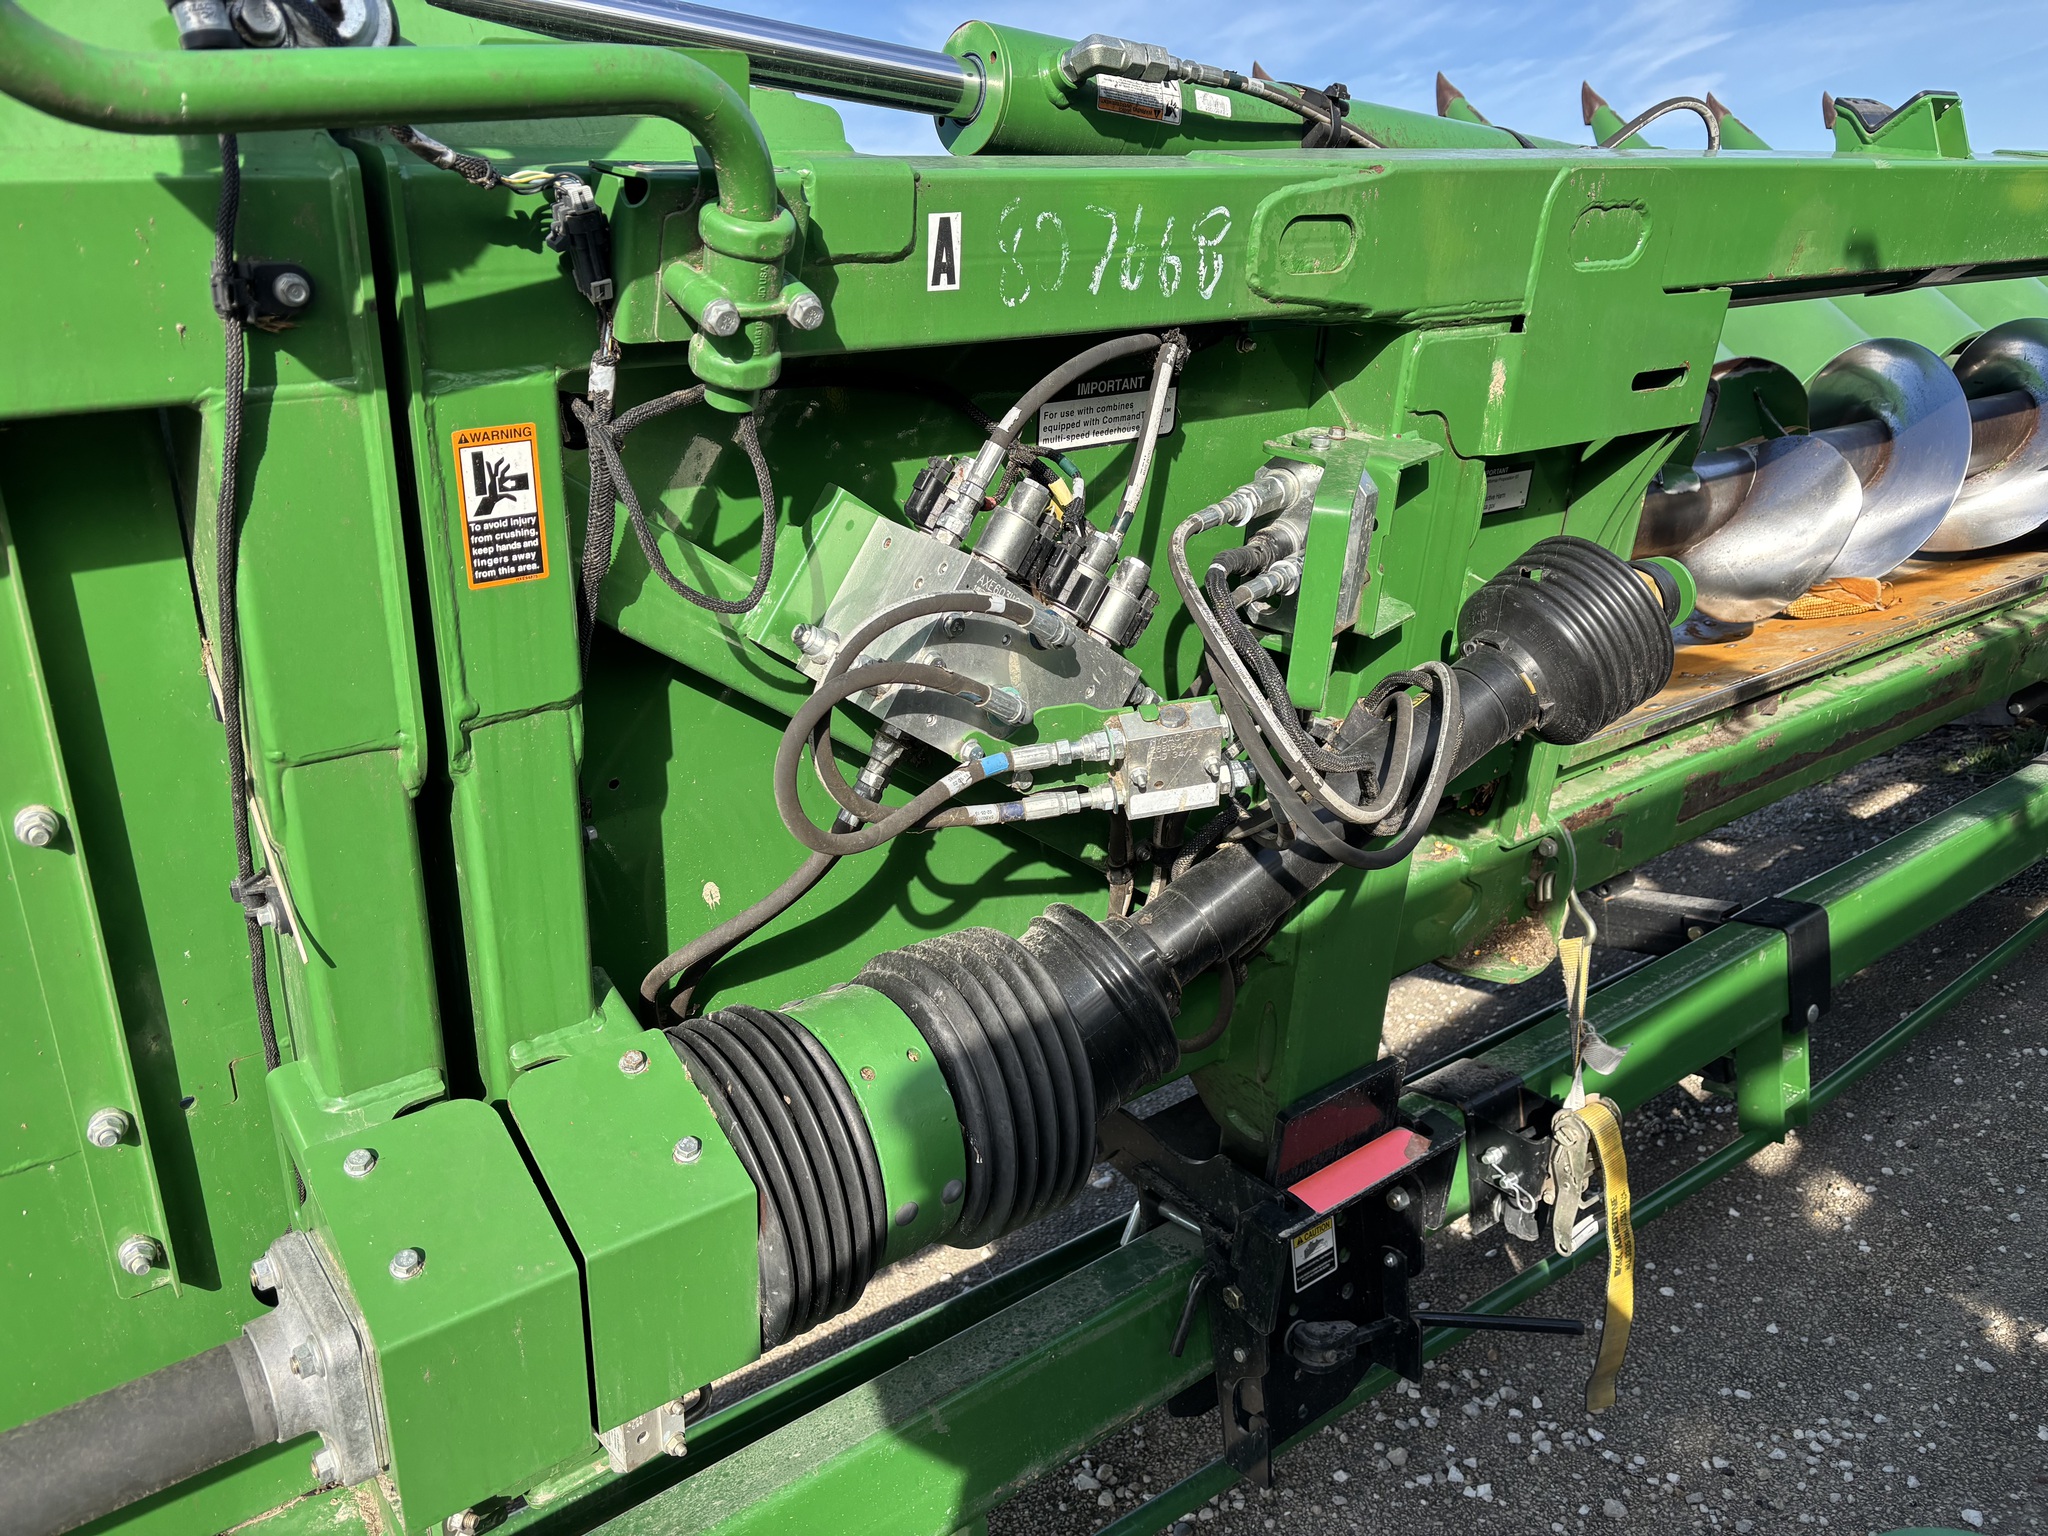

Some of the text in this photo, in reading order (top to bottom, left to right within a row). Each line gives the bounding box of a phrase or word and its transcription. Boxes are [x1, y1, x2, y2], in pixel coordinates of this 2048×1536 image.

[931, 216, 956, 286] A
[1077, 376, 1146, 396] IMPORTANT
[1043, 401, 1134, 421] For use with combines
[469, 426, 532, 443] WARNING
[1042, 419, 1081, 434] equipped
[1083, 417, 1100, 427] with
[1042, 424, 1141, 445] multi-speed feederhouse
[469, 515, 537, 533] To avoid injury
[470, 528, 539, 544] from crushing,
[472, 538, 539, 556] keep hands and
[473, 550, 537, 568] fingers away
[474, 561, 540, 579] from this area.
[1303, 1220, 1330, 1242] CAUTION
